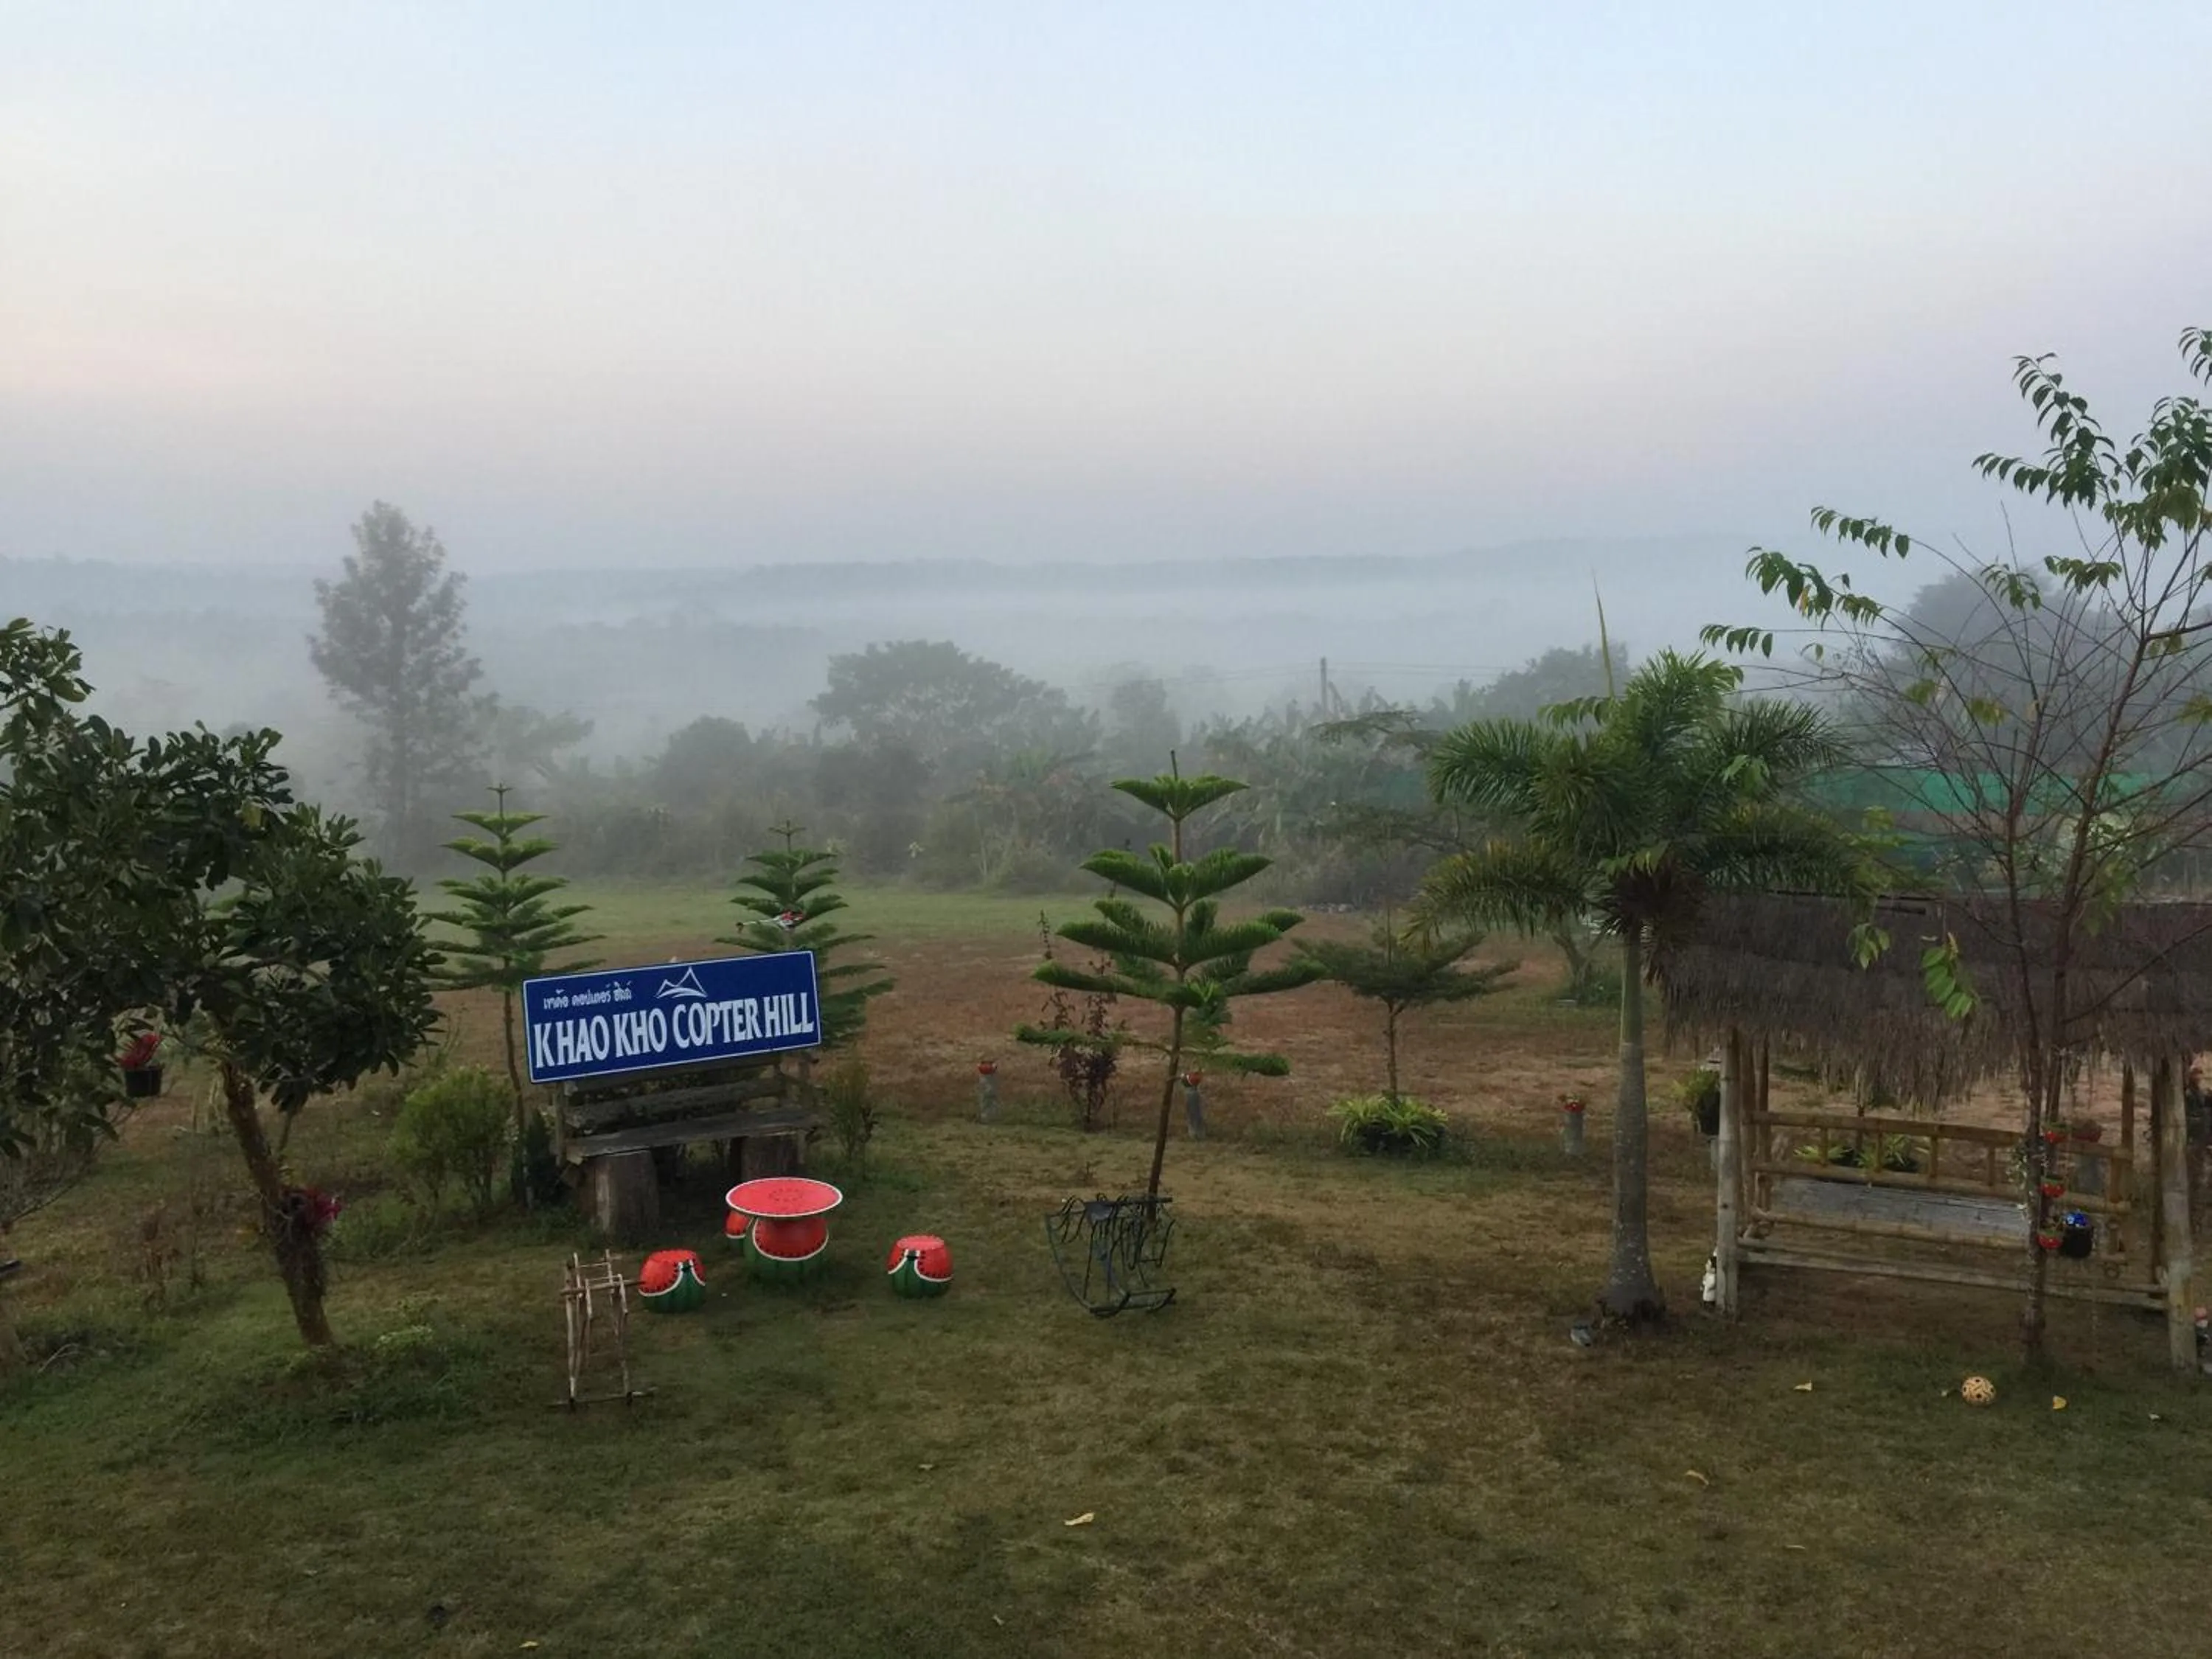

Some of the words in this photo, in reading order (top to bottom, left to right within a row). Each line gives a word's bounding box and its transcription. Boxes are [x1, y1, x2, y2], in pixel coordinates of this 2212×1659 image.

[534, 1015, 611, 1068] KHAO
[613, 1008, 666, 1057] KHO
[672, 998, 764, 1048] COPTER
[764, 992, 814, 1037] HILL
